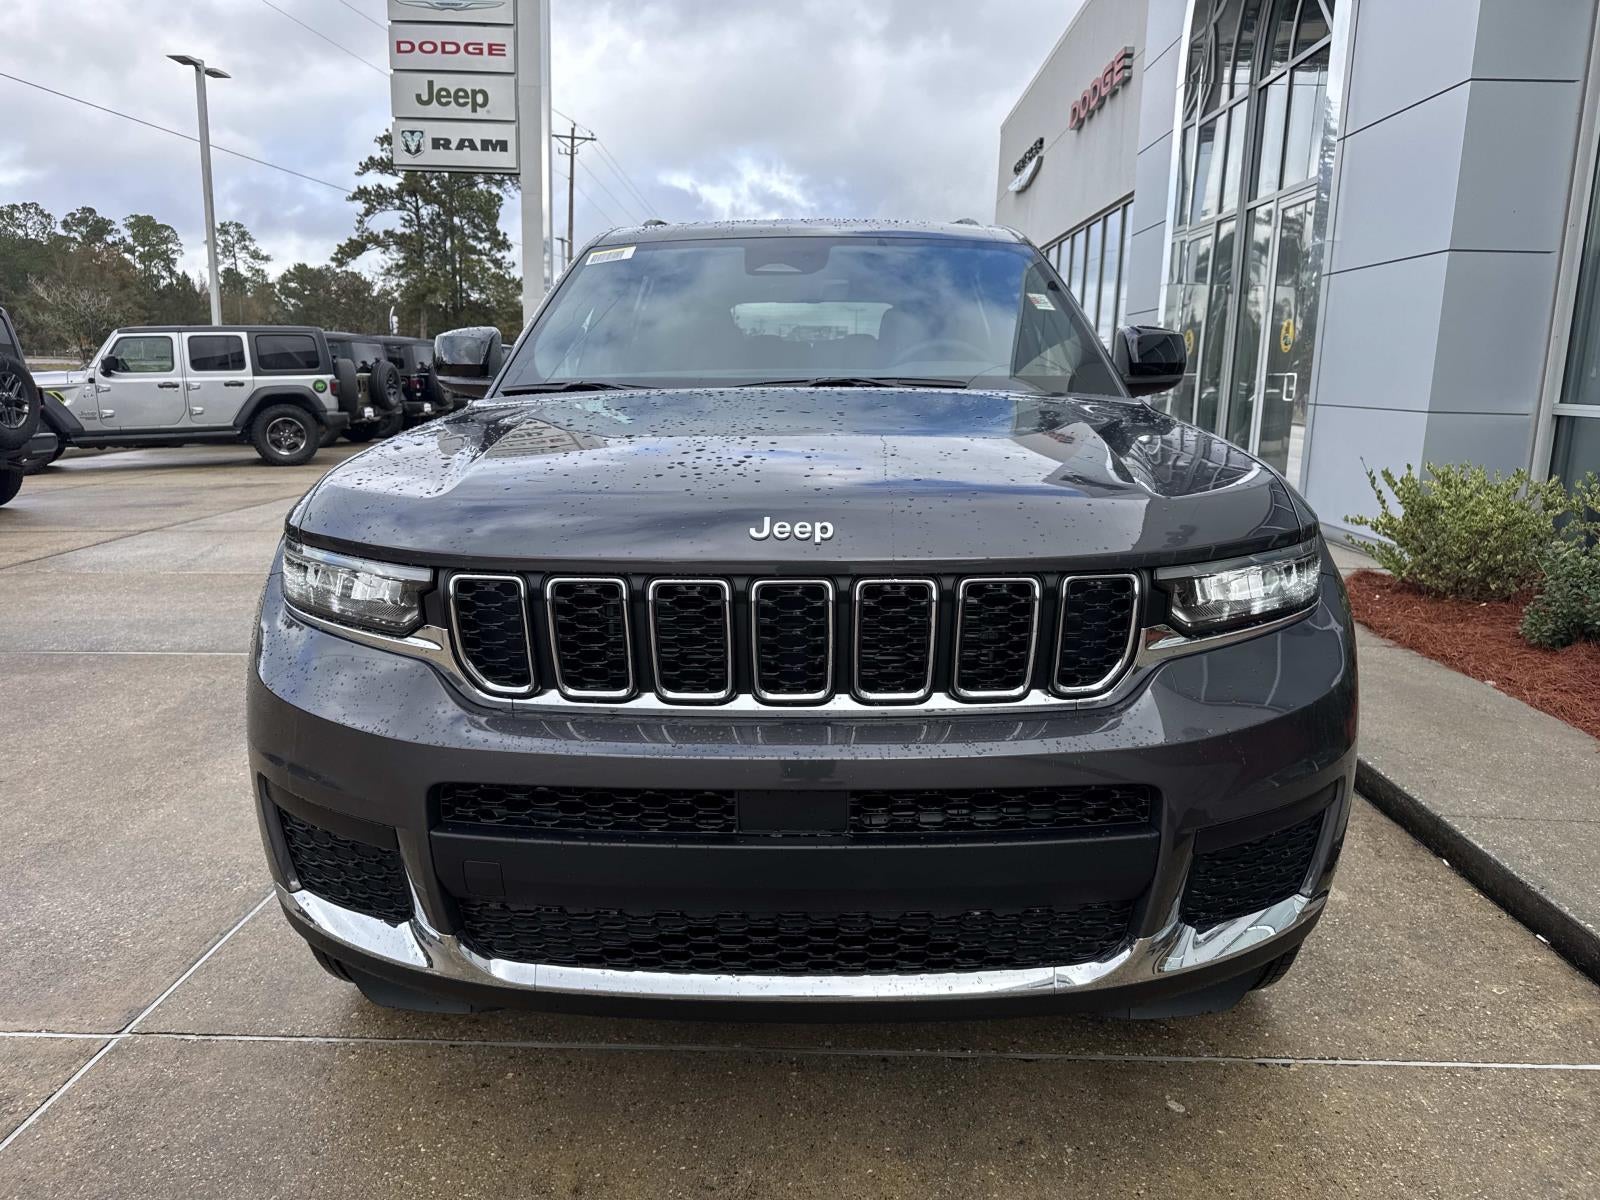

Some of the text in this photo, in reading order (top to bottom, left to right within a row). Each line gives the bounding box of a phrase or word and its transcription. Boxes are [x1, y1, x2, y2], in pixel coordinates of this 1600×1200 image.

[395, 40, 507, 57] DODGE
[415, 79, 490, 113] Jeep
[1068, 46, 1133, 131] DODGE
[431, 137, 508, 153] RAM
[749, 516, 834, 544] Jeep
